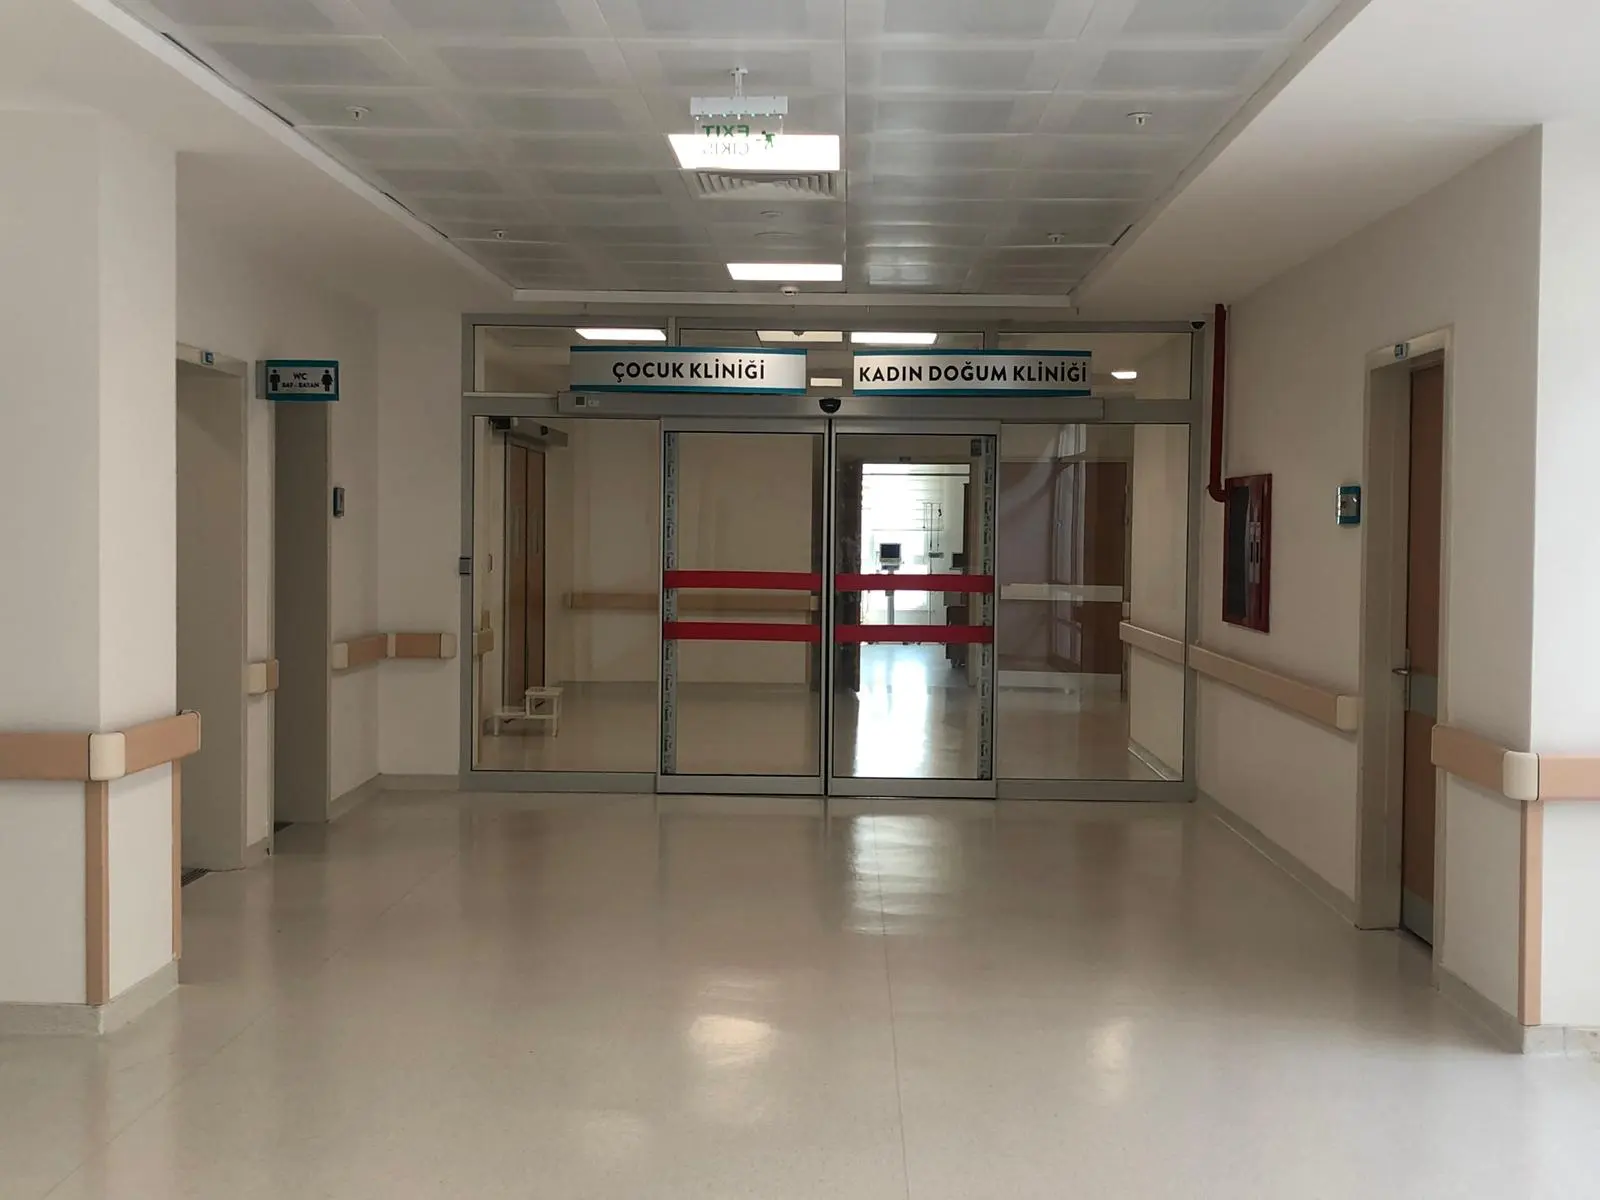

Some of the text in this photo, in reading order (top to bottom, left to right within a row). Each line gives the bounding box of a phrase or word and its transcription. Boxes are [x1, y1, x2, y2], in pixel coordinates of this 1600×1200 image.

[293, 371, 308, 381] WC
[612, 358, 765, 383] ÇOCUK KLİNİĞİ
[859, 361, 1087, 383] KADIN DOĞUM KLİNİĞİ
